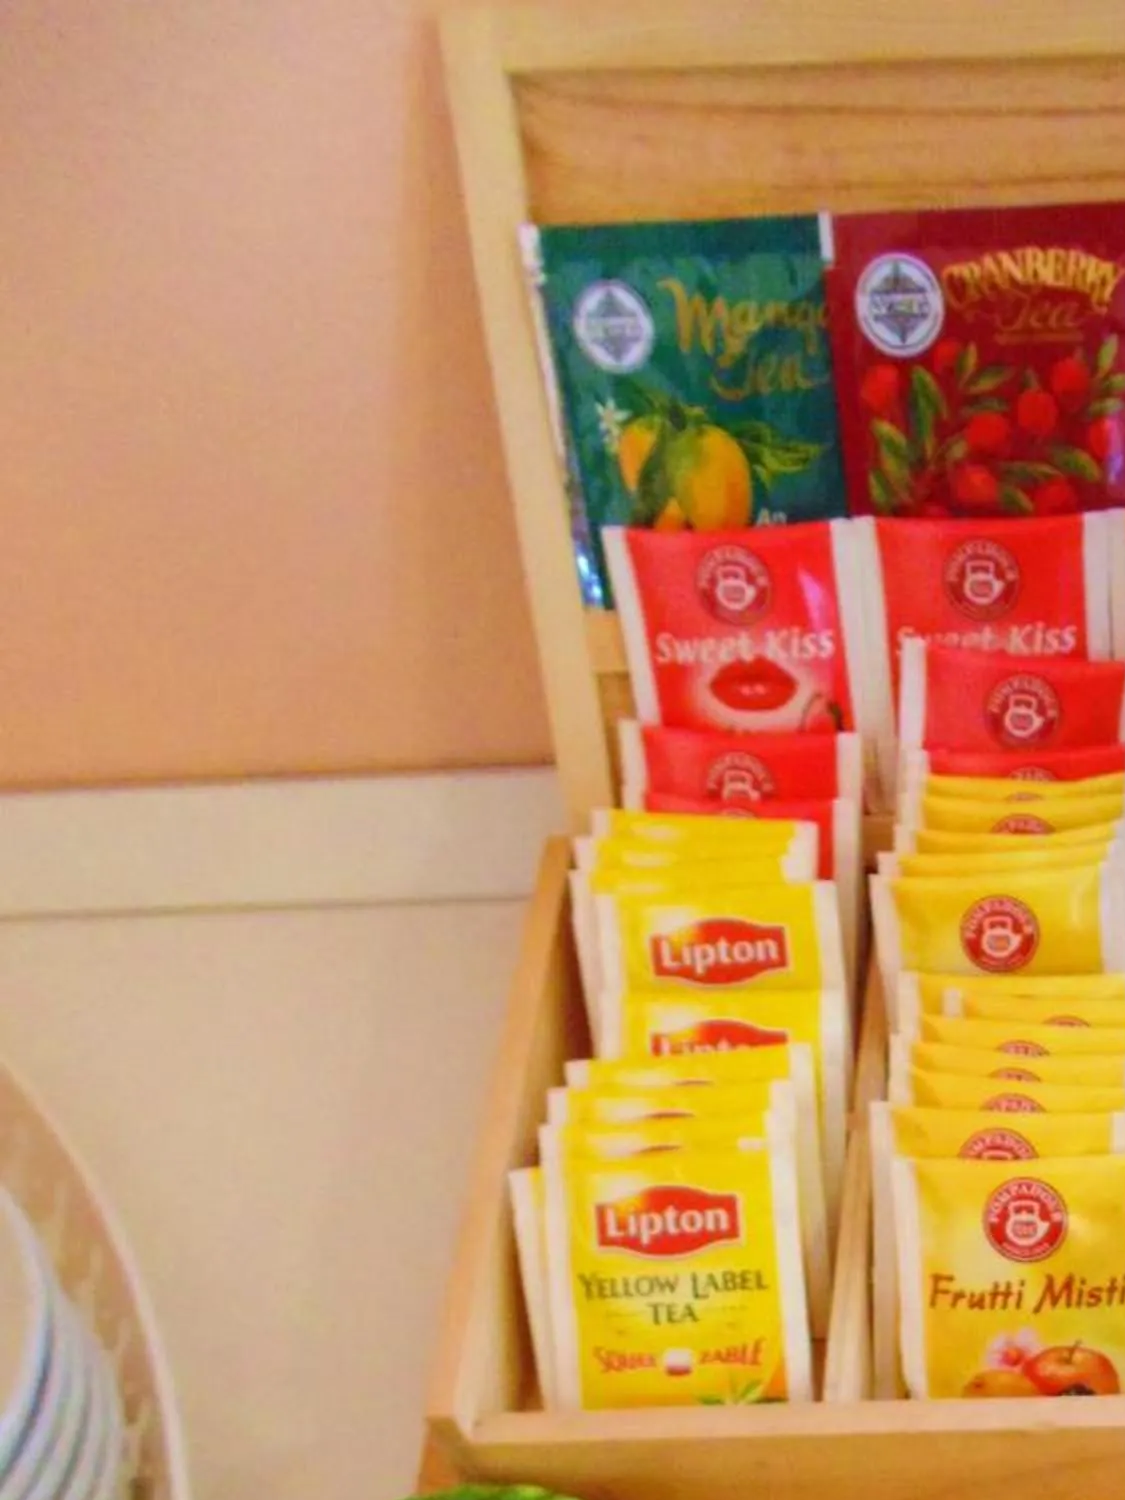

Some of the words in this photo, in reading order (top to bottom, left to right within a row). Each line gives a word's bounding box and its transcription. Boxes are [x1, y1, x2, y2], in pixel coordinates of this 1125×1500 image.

[656, 277, 829, 368] Mang
[655, 631, 754, 664] Sweet
[764, 627, 835, 660] Kiss
[1006, 622, 1077, 656] Kiss
[660, 937, 779, 975] Lipton
[606, 1203, 730, 1247] Lipton
[577, 1271, 681, 1300] YELLOW
[690, 1269, 769, 1300] LABEL
[928, 1273, 1025, 1310] Frutti
[646, 1300, 699, 1326] TEA
